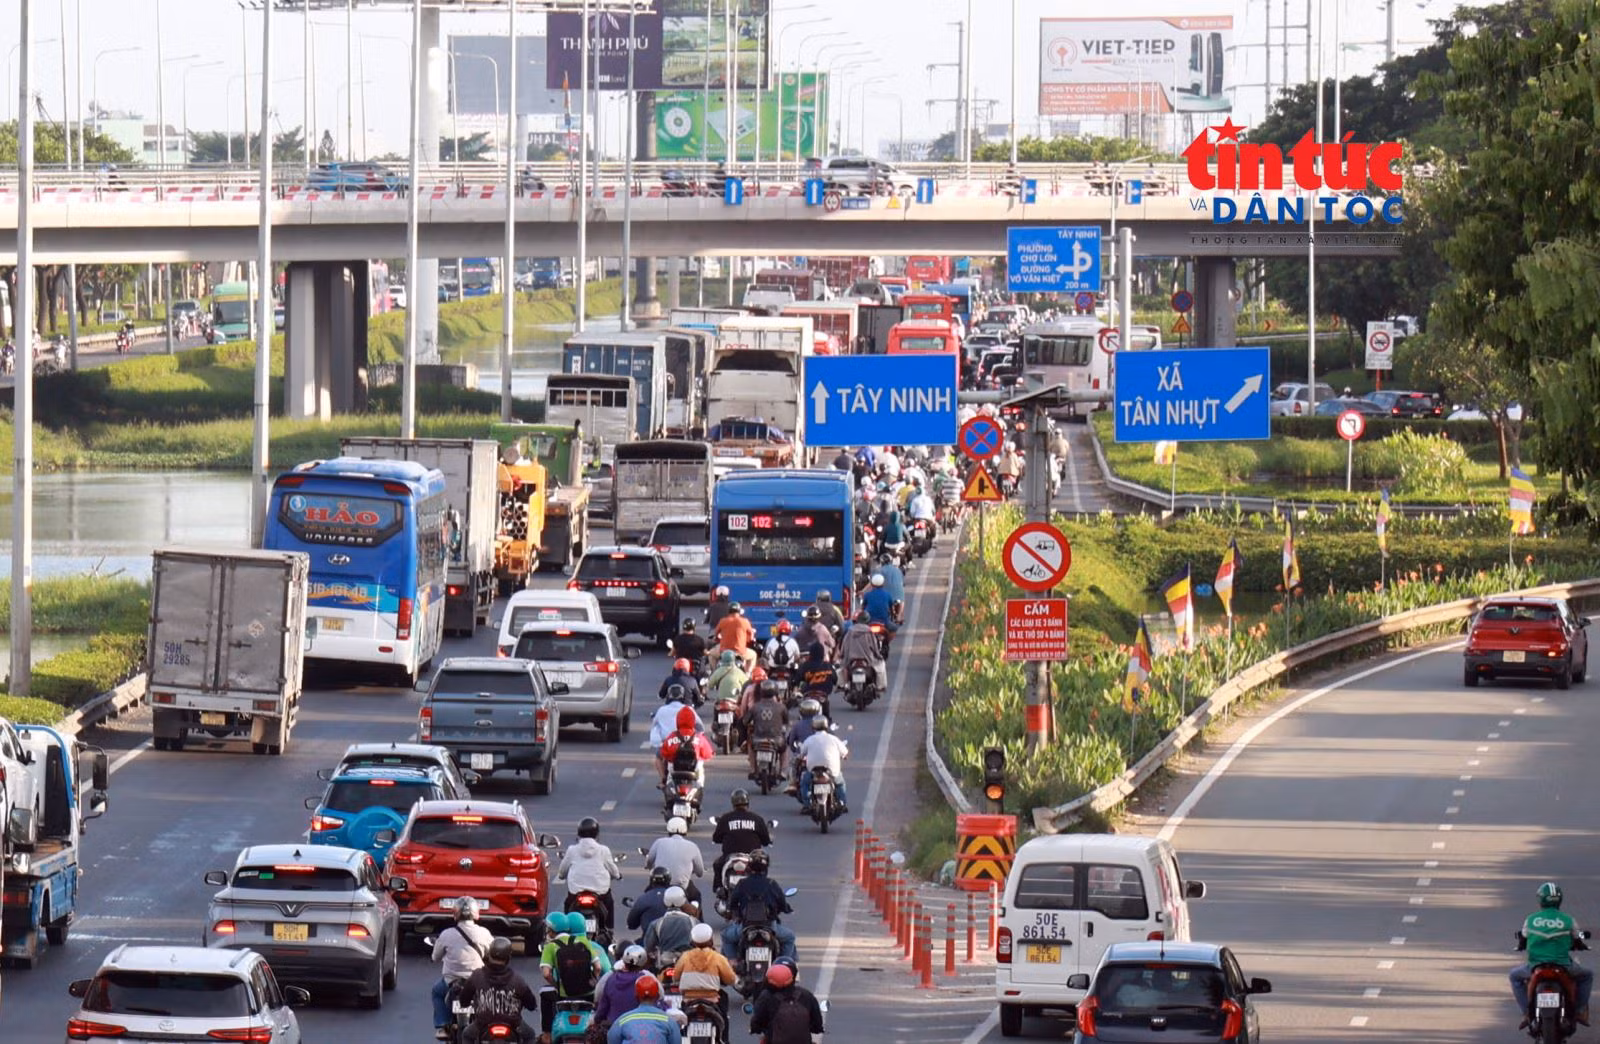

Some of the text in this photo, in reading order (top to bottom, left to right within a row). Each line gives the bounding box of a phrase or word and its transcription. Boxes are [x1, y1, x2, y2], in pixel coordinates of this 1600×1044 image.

[1065, 281, 1079, 289] 200
[1157, 361, 1184, 391] XÃ
[836, 383, 951, 413] TÂY NINH
[1120, 396, 1220, 430] TÂN NHỰT
[304, 502, 380, 525] HẢO
[730, 516, 747, 528] 102
[752, 516, 772, 529] 102
[1024, 600, 1050, 616] CẤM
[164, 641, 182, 654] 50H
[163, 653, 190, 666] 29285
[728, 820, 756, 831] VIET NAM
[1036, 912, 1059, 926] 50E
[1532, 917, 1565, 929] Grab
[1022, 925, 1066, 939] 861.54
